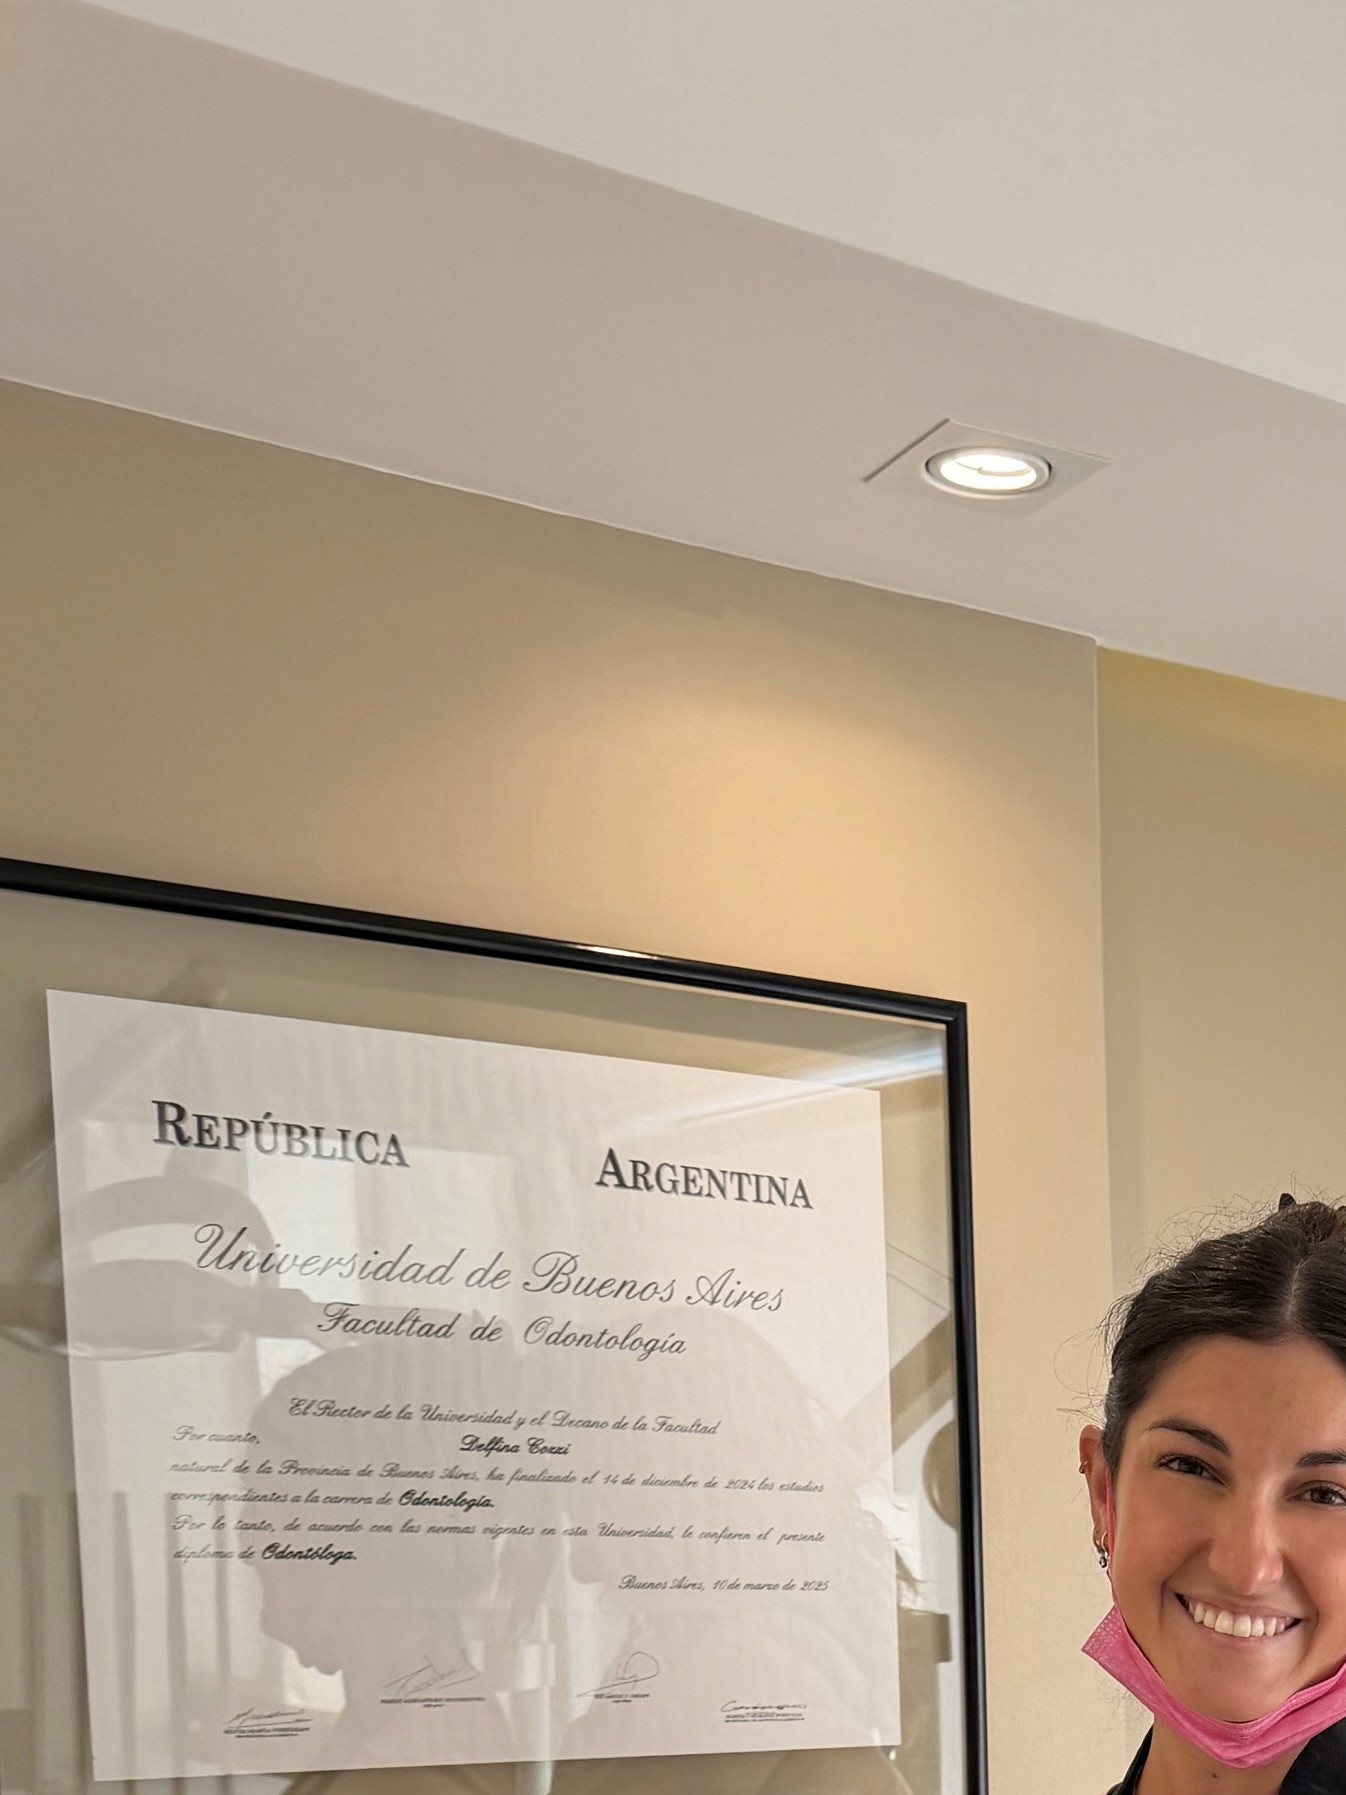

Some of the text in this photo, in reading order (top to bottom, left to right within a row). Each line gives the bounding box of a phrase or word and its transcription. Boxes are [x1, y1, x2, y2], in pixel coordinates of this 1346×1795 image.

[594, 1146, 814, 1211] ARGENTINA
[193, 1221, 784, 1314] Universidad de Buenos Aires
[316, 1301, 688, 1361] Facultad de Odontología
[288, 1397, 720, 1434] El Rector de la Universidad y el Decano de la Facultad
[173, 1425, 207, 1442] Por
[459, 1434, 521, 1458] Delfina
[170, 1459, 231, 1473] natural
[233, 1459, 249, 1474] de
[256, 1460, 272, 1475] la
[278, 1459, 350, 1476] Provincia
[357, 1462, 373, 1478] de
[379, 1462, 434, 1480] Buenos
[484, 1466, 504, 1483] ha
[506, 1468, 576, 1486] finalizado
[582, 1470, 600, 1485] el
[622, 1471, 636, 1487] de
[641, 1473, 699, 1489] diciembre
[704, 1474, 718, 1490] de
[757, 1474, 775, 1491] los
[778, 1478, 825, 1493] estudios
[292, 1494, 301, 1504] a
[304, 1489, 321, 1504] la
[322, 1493, 374, 1506] carrera
[375, 1490, 393, 1506] de
[172, 1514, 207, 1531] Por
[211, 1514, 227, 1530] lo
[283, 1517, 301, 1532] de
[307, 1517, 364, 1533] acuerdo
[369, 1523, 393, 1533] con
[400, 1519, 421, 1534] las
[426, 1523, 477, 1535] normas
[482, 1523, 536, 1540] vigentes
[540, 1526, 557, 1537] en
[562, 1524, 588, 1538] esta
[681, 1524, 694, 1540] le
[698, 1526, 752, 1544] confieren
[757, 1527, 773, 1542] el
[776, 1531, 826, 1547] presente
[173, 1545, 236, 1565] diploma
[237, 1545, 255, 1561] de
[618, 1574, 669, 1590] Buenos
[727, 1577, 741, 1592] de
[743, 1581, 781, 1592] marzo
[781, 1577, 797, 1592] de
